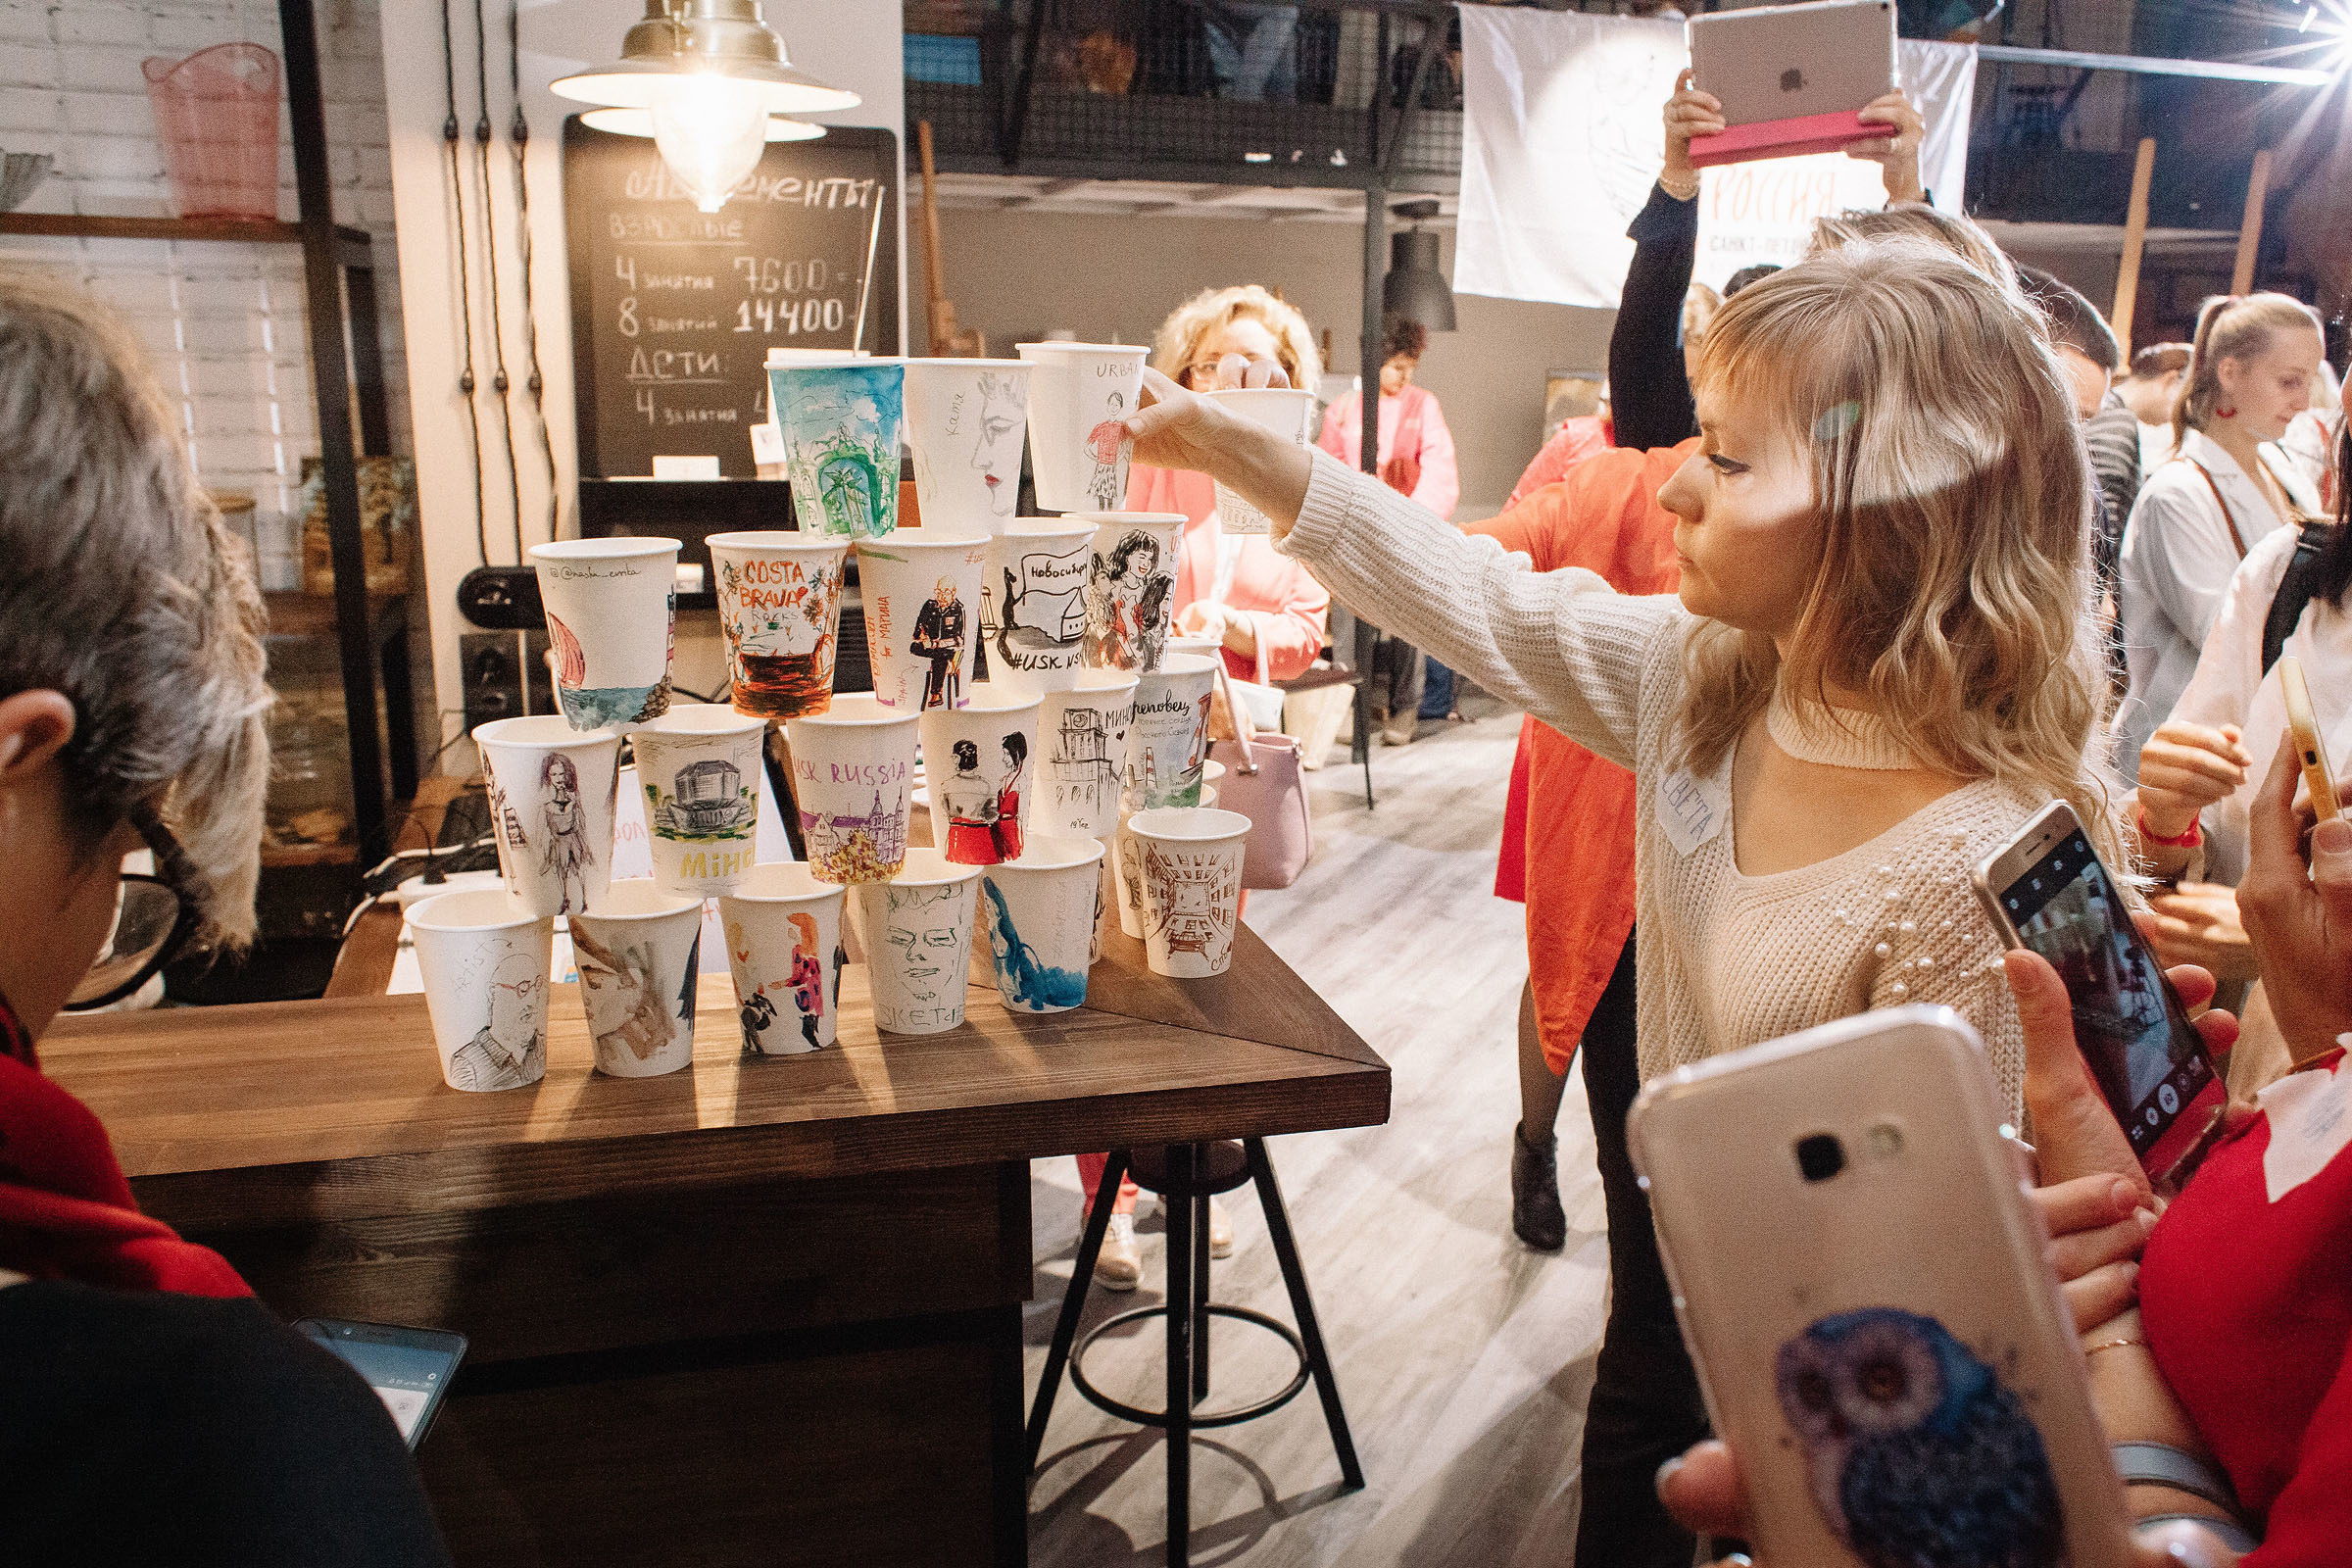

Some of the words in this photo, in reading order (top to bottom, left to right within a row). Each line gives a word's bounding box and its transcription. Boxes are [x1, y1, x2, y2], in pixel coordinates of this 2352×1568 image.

[614, 256, 638, 291] 4
[617, 297, 640, 336] 8
[635, 389, 655, 425] 4
[743, 560, 805, 585] COSTA
[740, 585, 801, 611] BRAVA
[1011, 652, 1062, 671] #USK
[1066, 652, 1082, 669] NS
[1130, 688, 1192, 725] реповец
